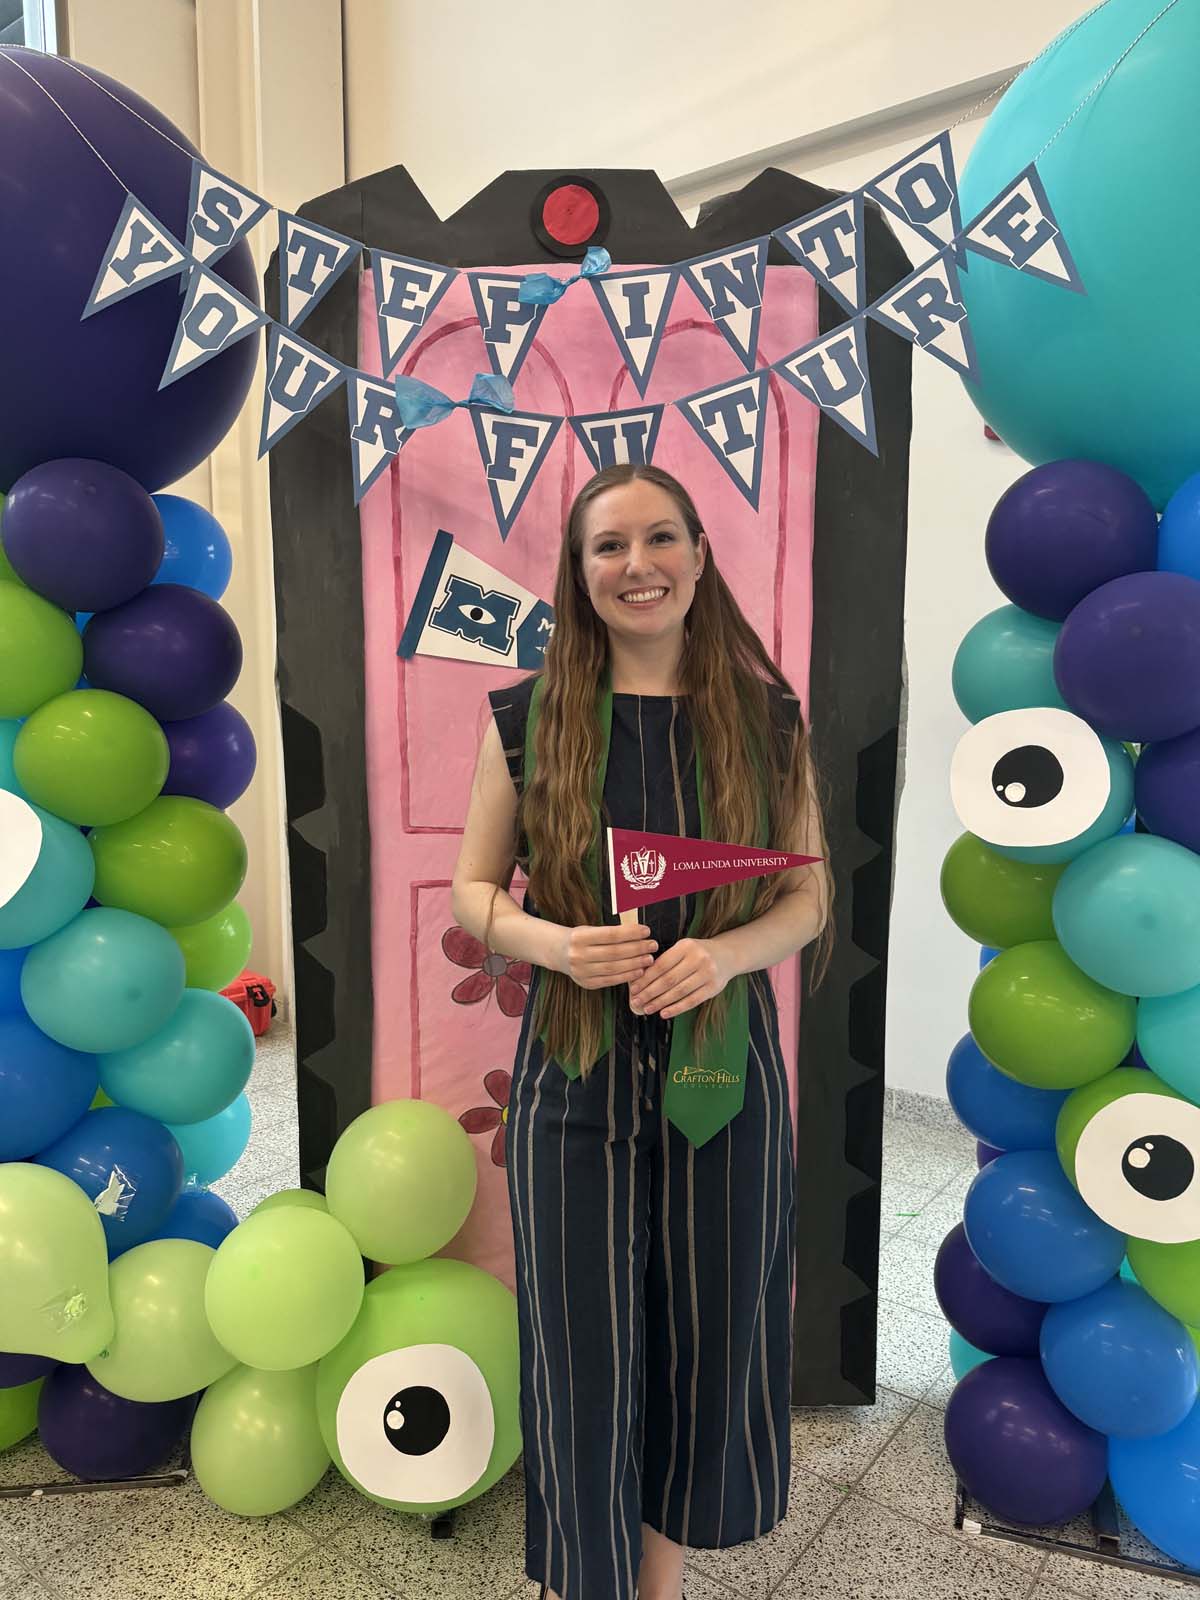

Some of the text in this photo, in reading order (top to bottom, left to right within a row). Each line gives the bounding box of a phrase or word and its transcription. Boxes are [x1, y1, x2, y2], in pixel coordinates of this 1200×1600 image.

[190, 161, 954, 344] STEP INTO
[107, 192, 1060, 482] YOUR FUTURE
[673, 857, 788, 871] LOMA LINDA UNIVERSITY
[673, 1070, 740, 1083] CRAFTON HILLS
